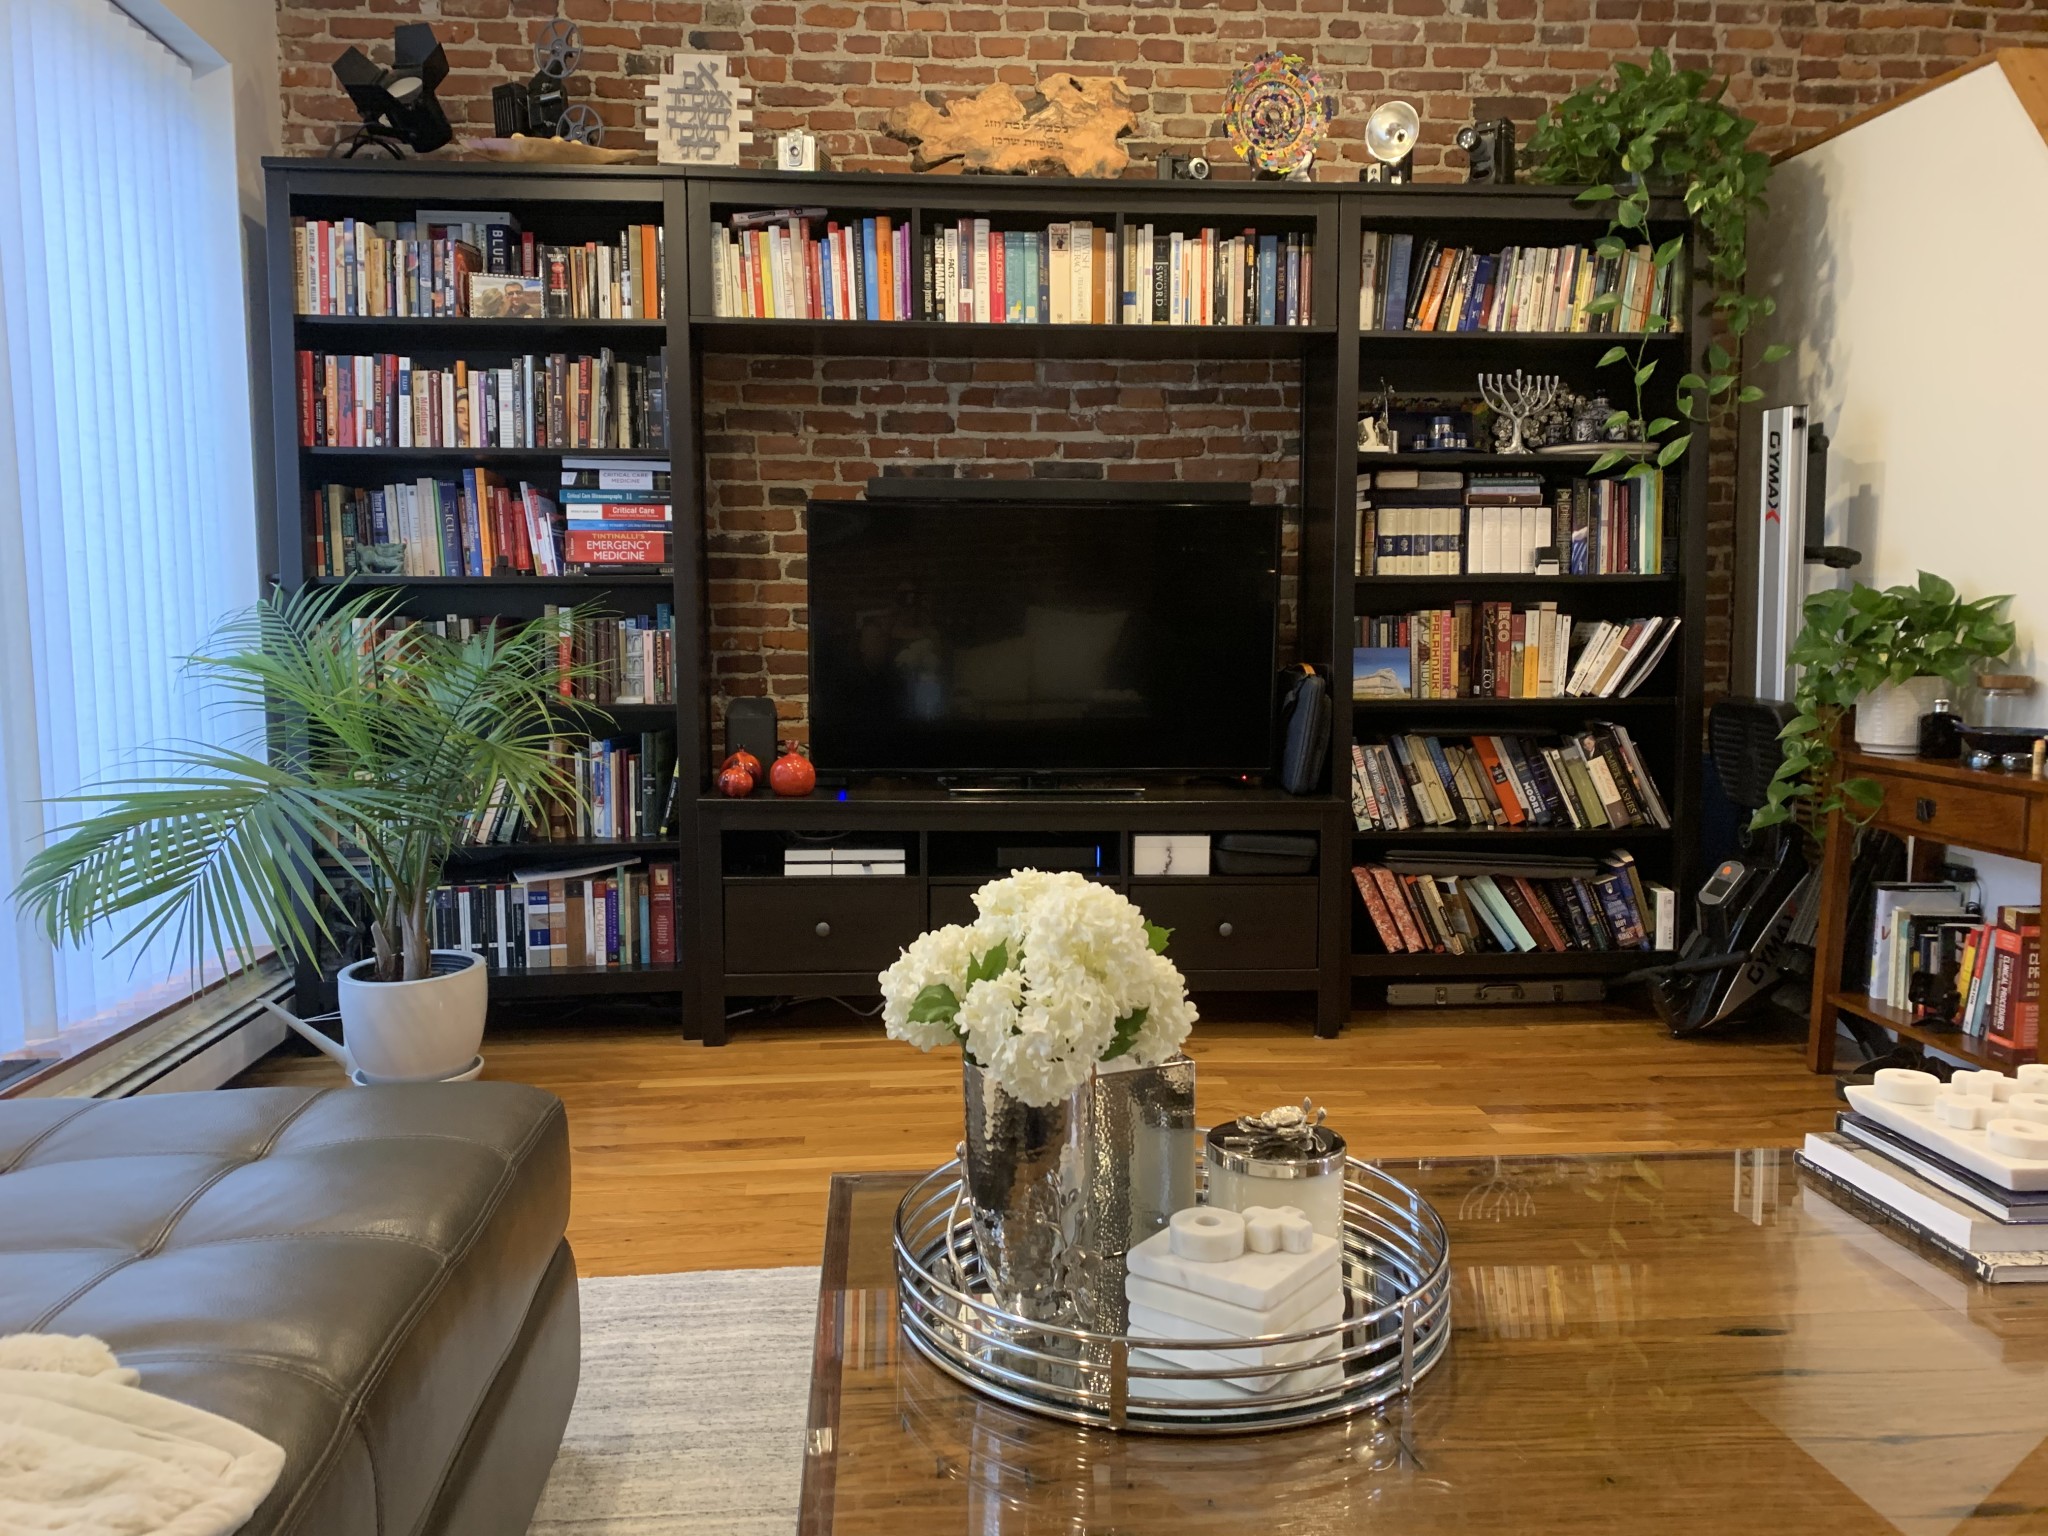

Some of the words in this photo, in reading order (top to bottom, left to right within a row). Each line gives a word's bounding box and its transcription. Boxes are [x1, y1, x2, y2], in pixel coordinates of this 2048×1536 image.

[683, 61, 718, 91] אם
[492, 229, 504, 265] BLUE
[934, 238, 944, 258] SON
[1074, 236, 1082, 273] LITERACY
[1080, 234, 1090, 268] JEWISH
[936, 264, 944, 300] HAMAS
[1155, 266, 1164, 306] SWORD
[1766, 431, 1781, 524] GYMAX
[374, 492, 384, 512] Intern
[376, 512, 384, 528] Blues
[446, 513, 454, 532] ICU
[586, 540, 652, 550] EMERGENCY
[594, 550, 646, 560] MEDICINE
[1498, 610, 1510, 643] ECO
[1483, 668, 1492, 689] ECO
[1604, 749, 1620, 778] EMBER
[1620, 787, 1637, 814] ASHES
[1523, 782, 1542, 814] MOORE
[596, 902, 604, 951] MACHIAVELLI
[2000, 956, 2010, 985] CLINICAL
[1997, 984, 2010, 1031] PROCEDURES
